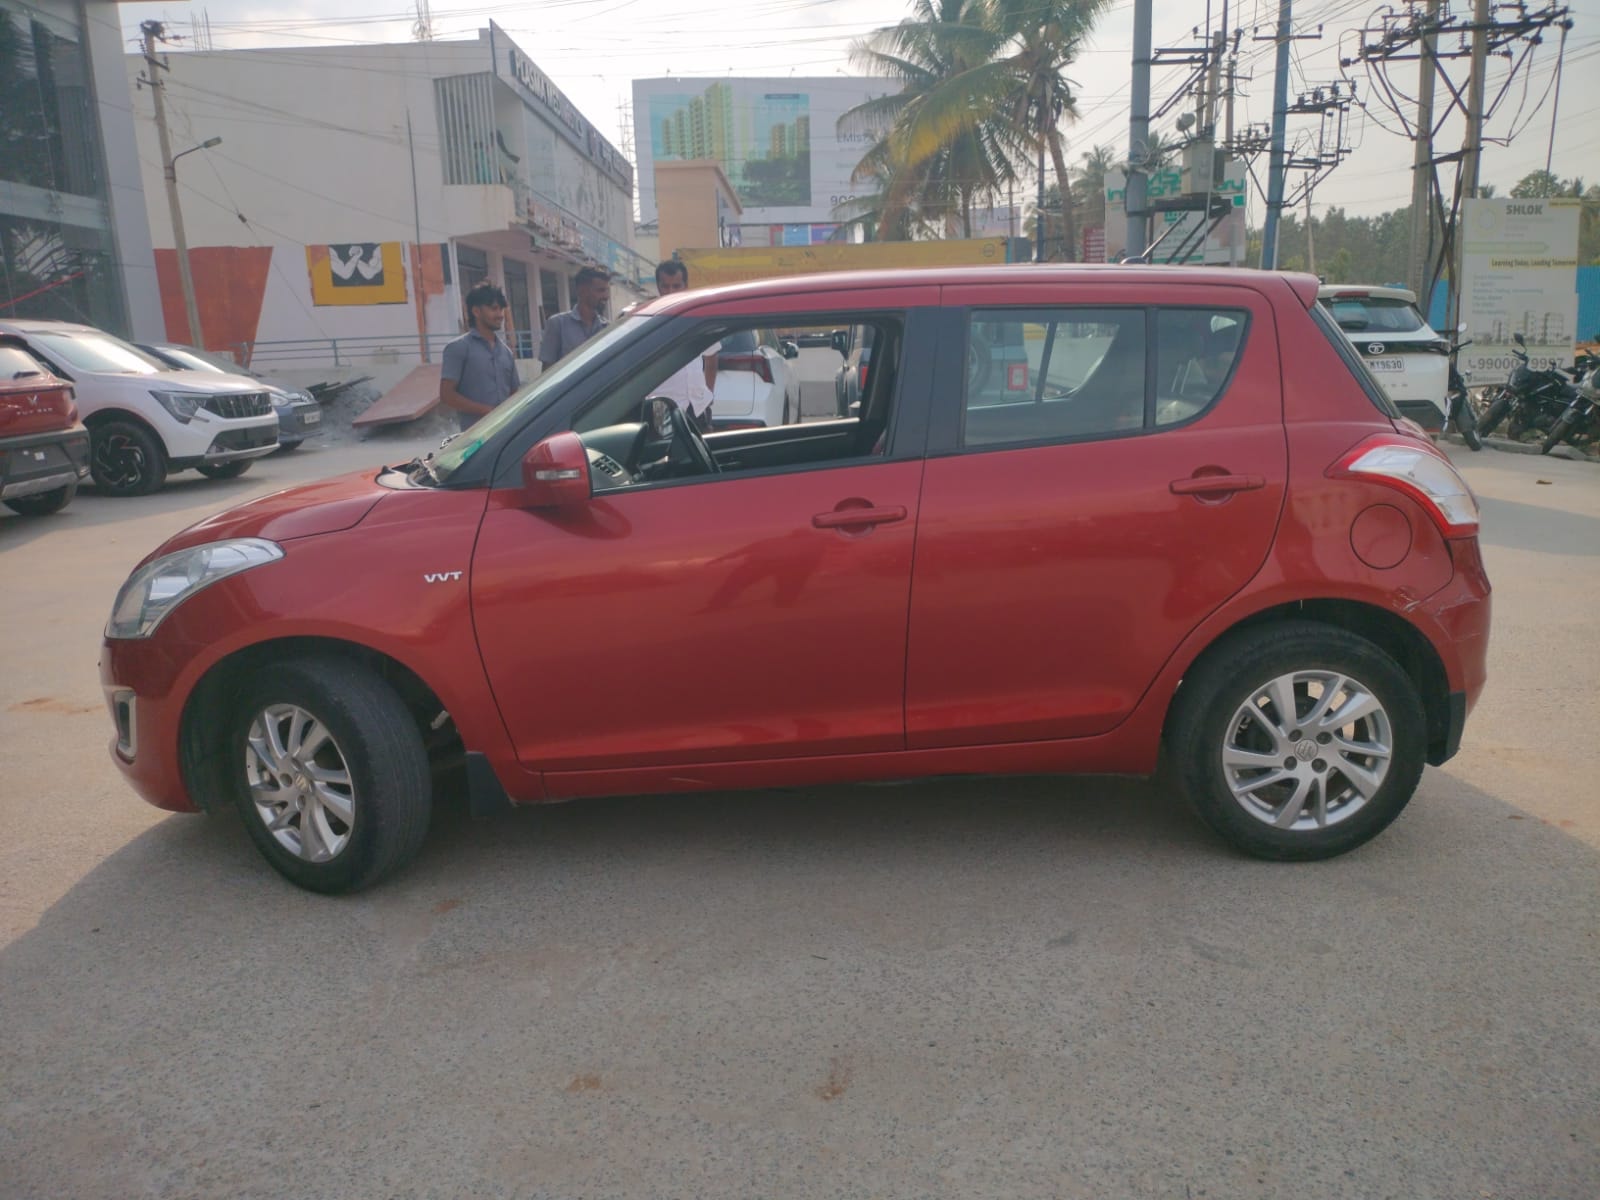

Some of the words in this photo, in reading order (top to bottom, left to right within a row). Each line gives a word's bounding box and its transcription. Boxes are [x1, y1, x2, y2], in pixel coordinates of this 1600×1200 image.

[1506, 204, 1543, 215] SHLOK
[1491, 258, 1514, 268] Learning
[1366, 360, 1402, 370] MY9630
[424, 571, 462, 583] VVT
